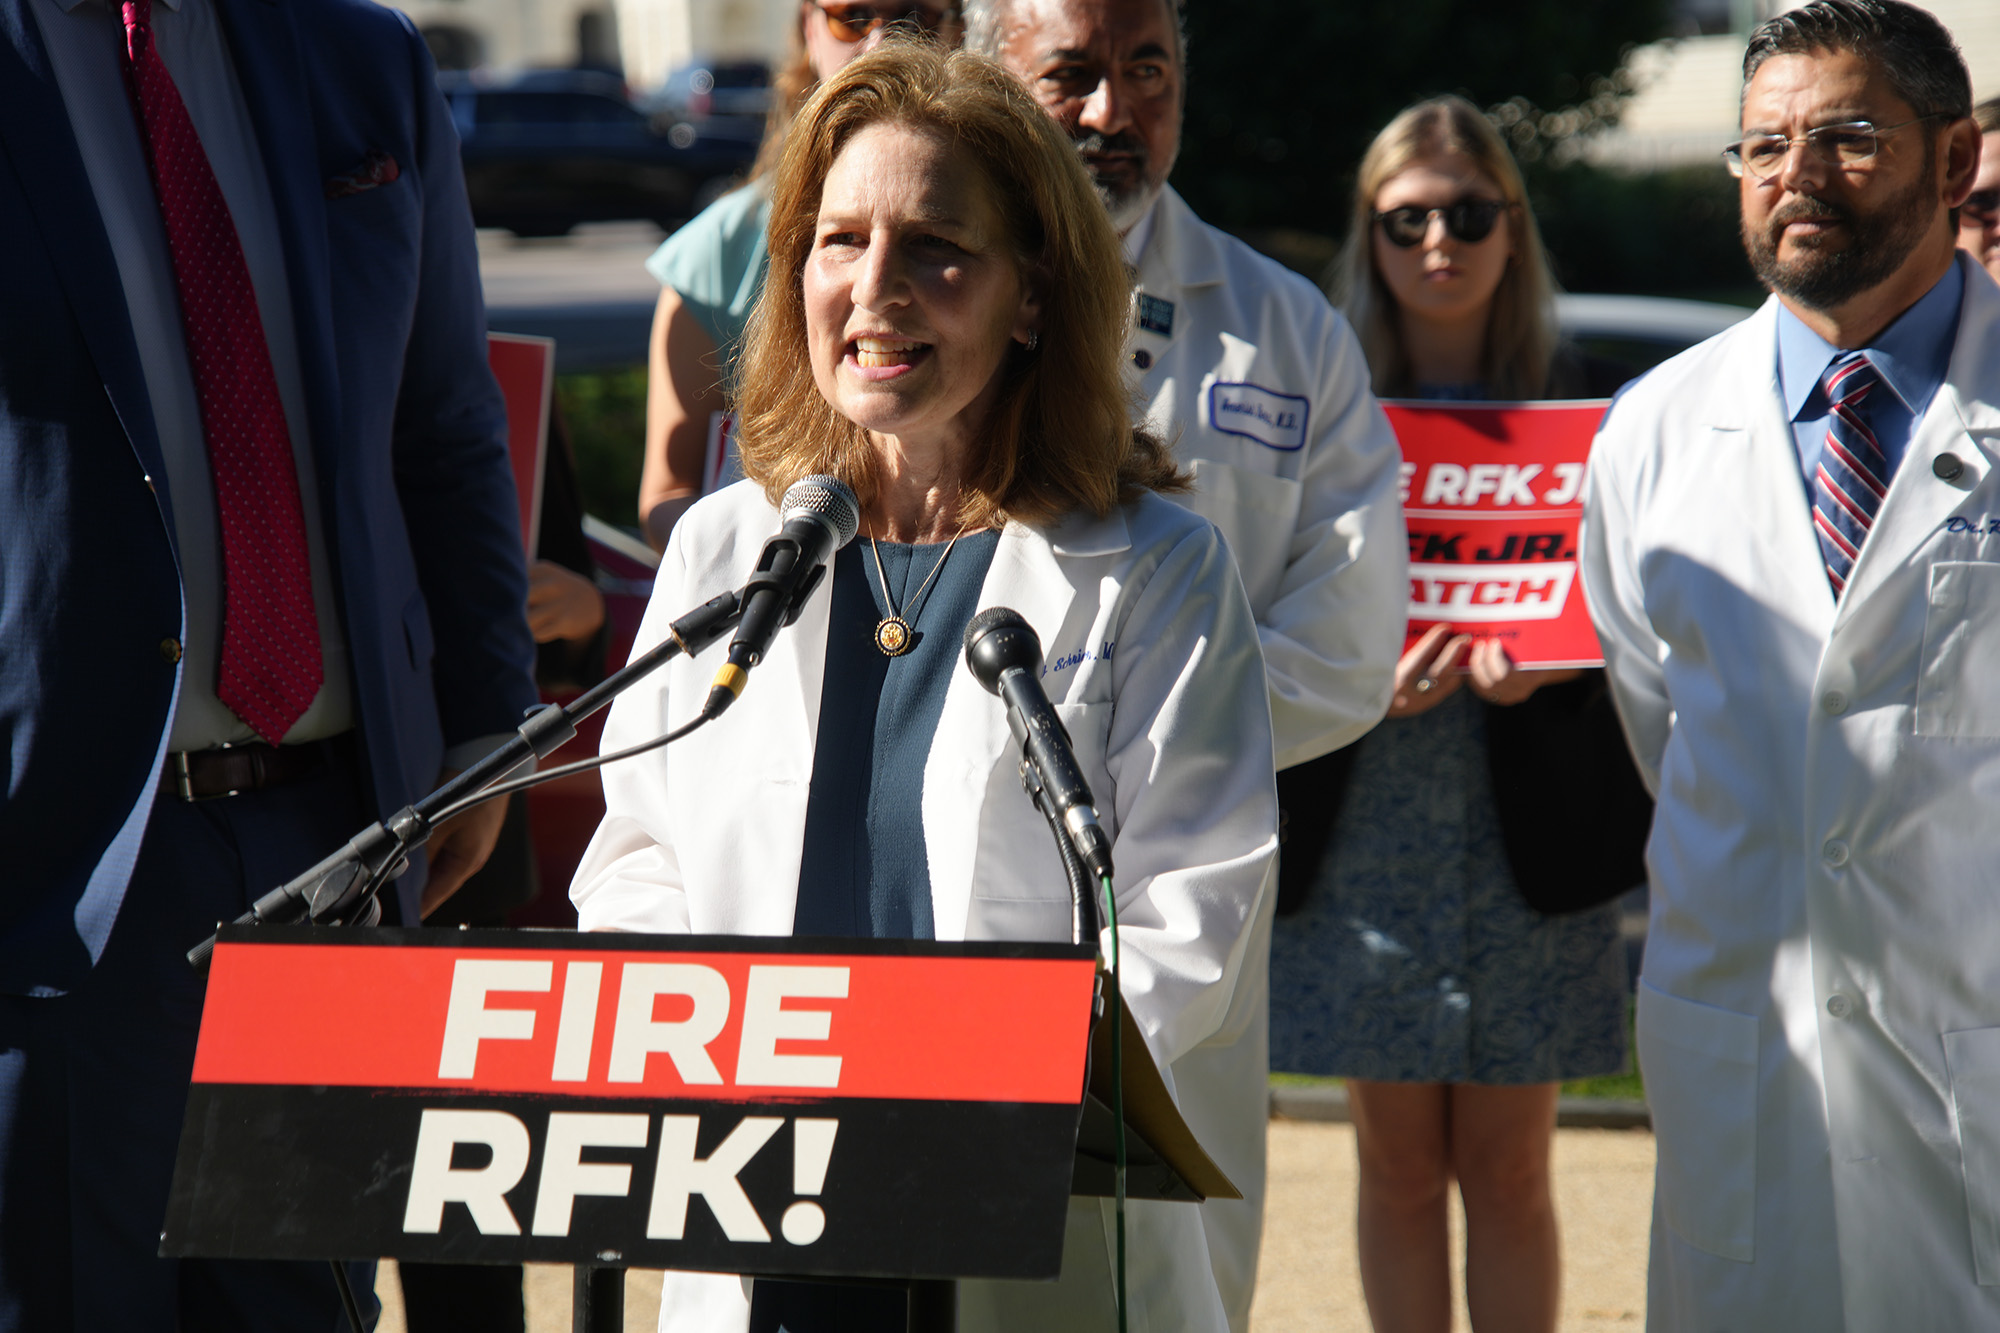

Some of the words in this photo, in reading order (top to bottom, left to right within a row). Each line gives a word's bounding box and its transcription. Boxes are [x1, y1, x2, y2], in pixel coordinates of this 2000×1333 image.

[1421, 462, 1544, 506] RFK
[1542, 462, 1584, 505] J
[1475, 533, 1574, 561] JR.
[438, 960, 850, 1088] FIRE
[403, 1110, 838, 1245] RFK!
